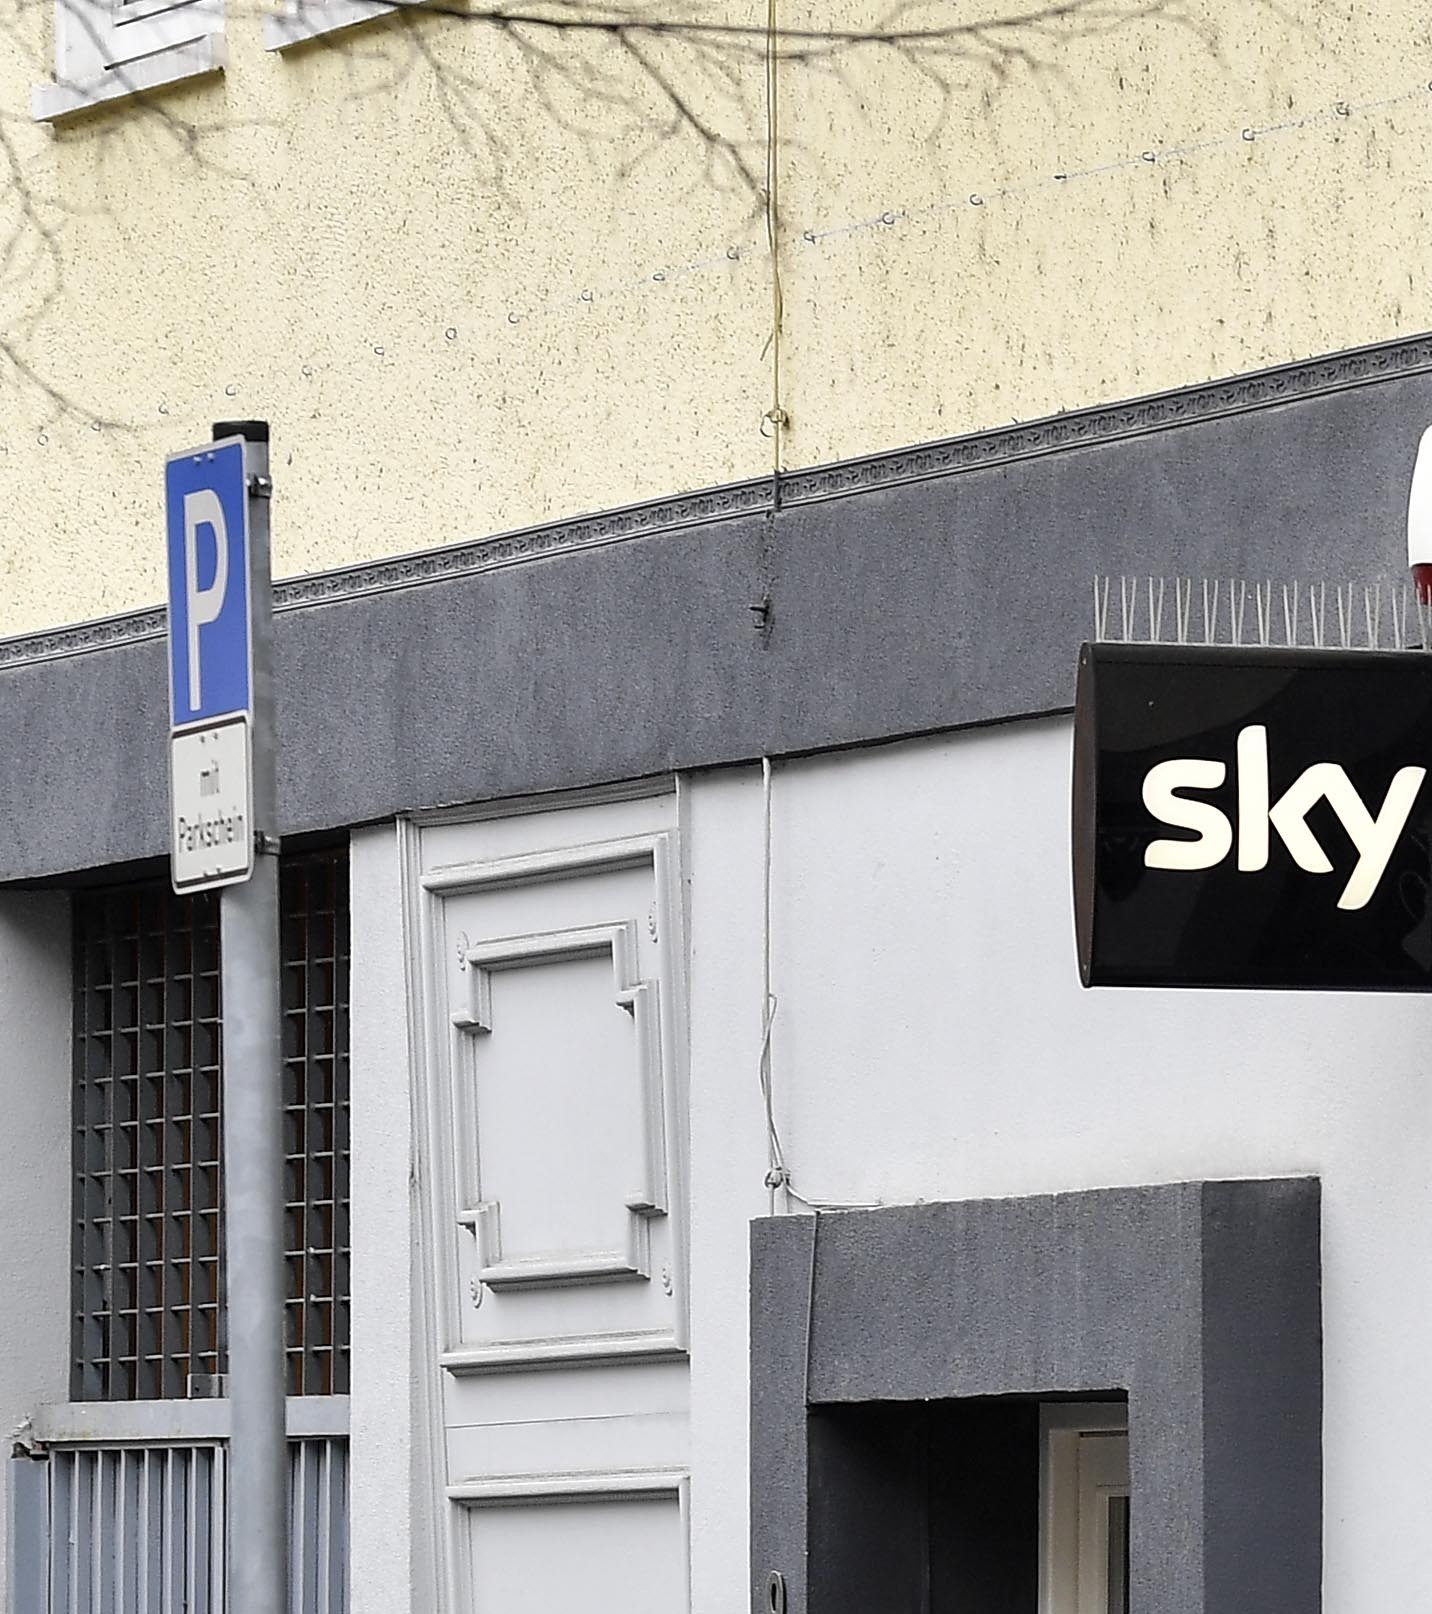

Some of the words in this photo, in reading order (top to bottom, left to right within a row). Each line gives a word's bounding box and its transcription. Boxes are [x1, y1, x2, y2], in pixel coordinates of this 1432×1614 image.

[183, 488, 229, 712] P
[179, 807, 245, 853] Parkschein
[199, 760, 220, 796] mit
[1141, 723, 1428, 911] sky
